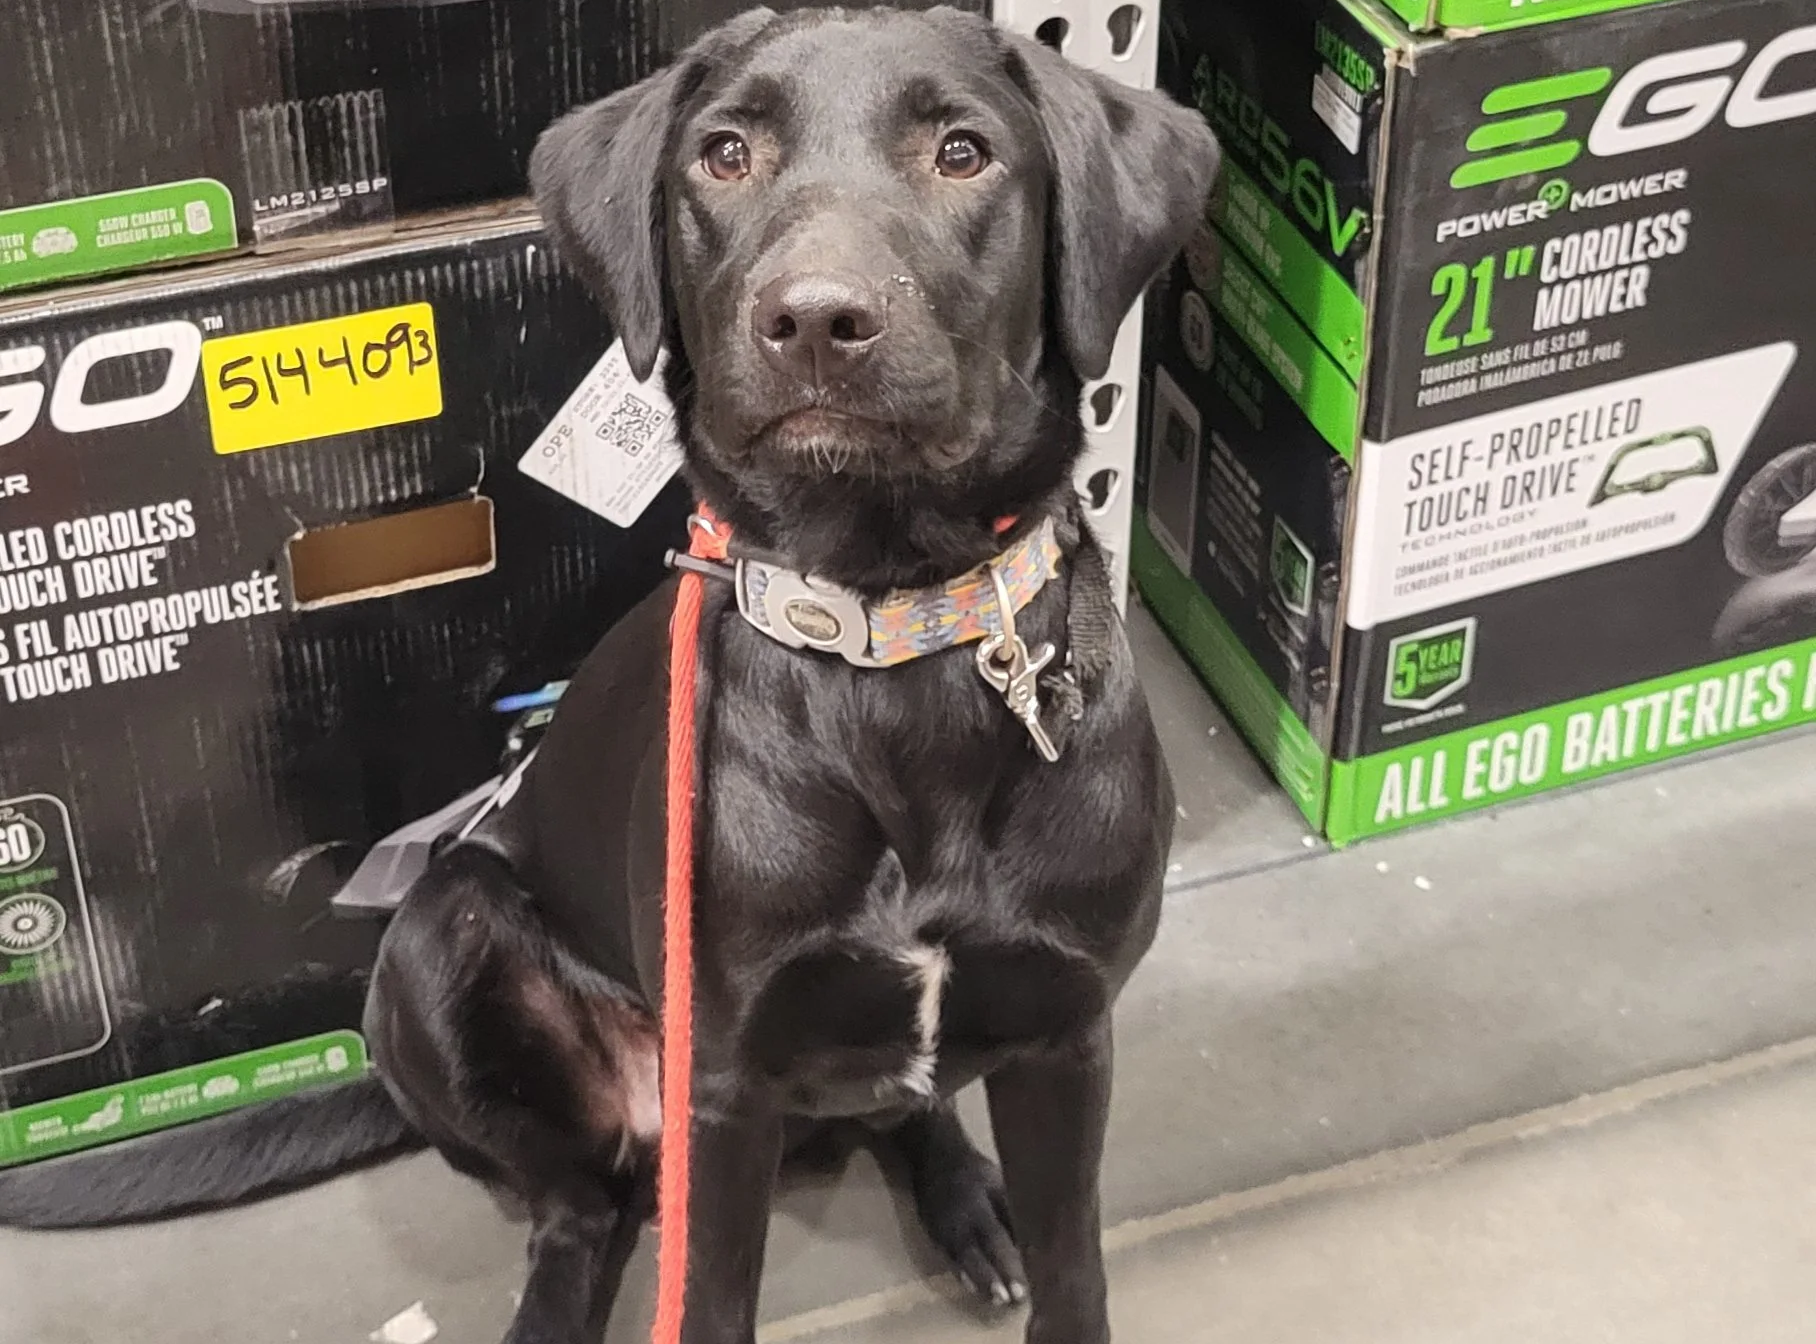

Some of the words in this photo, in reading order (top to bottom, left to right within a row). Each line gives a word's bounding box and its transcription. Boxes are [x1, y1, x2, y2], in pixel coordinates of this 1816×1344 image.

[254, 177, 388, 212] LM2125SP
[1436, 199, 1550, 243] POWER
[1569, 167, 1688, 212] MOWER
[1540, 208, 1692, 284] CORDLESS
[1533, 263, 1650, 332] MOWER
[219, 322, 435, 410] 5144093
[1420, 357, 1479, 386] TONDEUSE
[1480, 347, 1512, 371] SANS
[1532, 338, 1547, 358] DE
[1567, 329, 1588, 350] CM
[1558, 352, 1574, 373] DE
[542, 423, 574, 458] OPE
[1407, 396, 1643, 491] SELF-PROPELLED
[54, 499, 196, 560] CORDLESS
[1401, 508, 1538, 553] TECHNOLOGY
[1403, 477, 1490, 536] TOUCH
[14, 618, 59, 661] FIL
[64, 570, 281, 653] AUTOPROPULSÉE
[1, 652, 92, 703] TOUCH
[1393, 642, 1419, 696] 5
[1418, 638, 1462, 672] YEAR
[1374, 750, 1449, 824] ALL
[1462, 722, 1551, 800] EGO
[1561, 656, 1794, 774] BATTERIES
